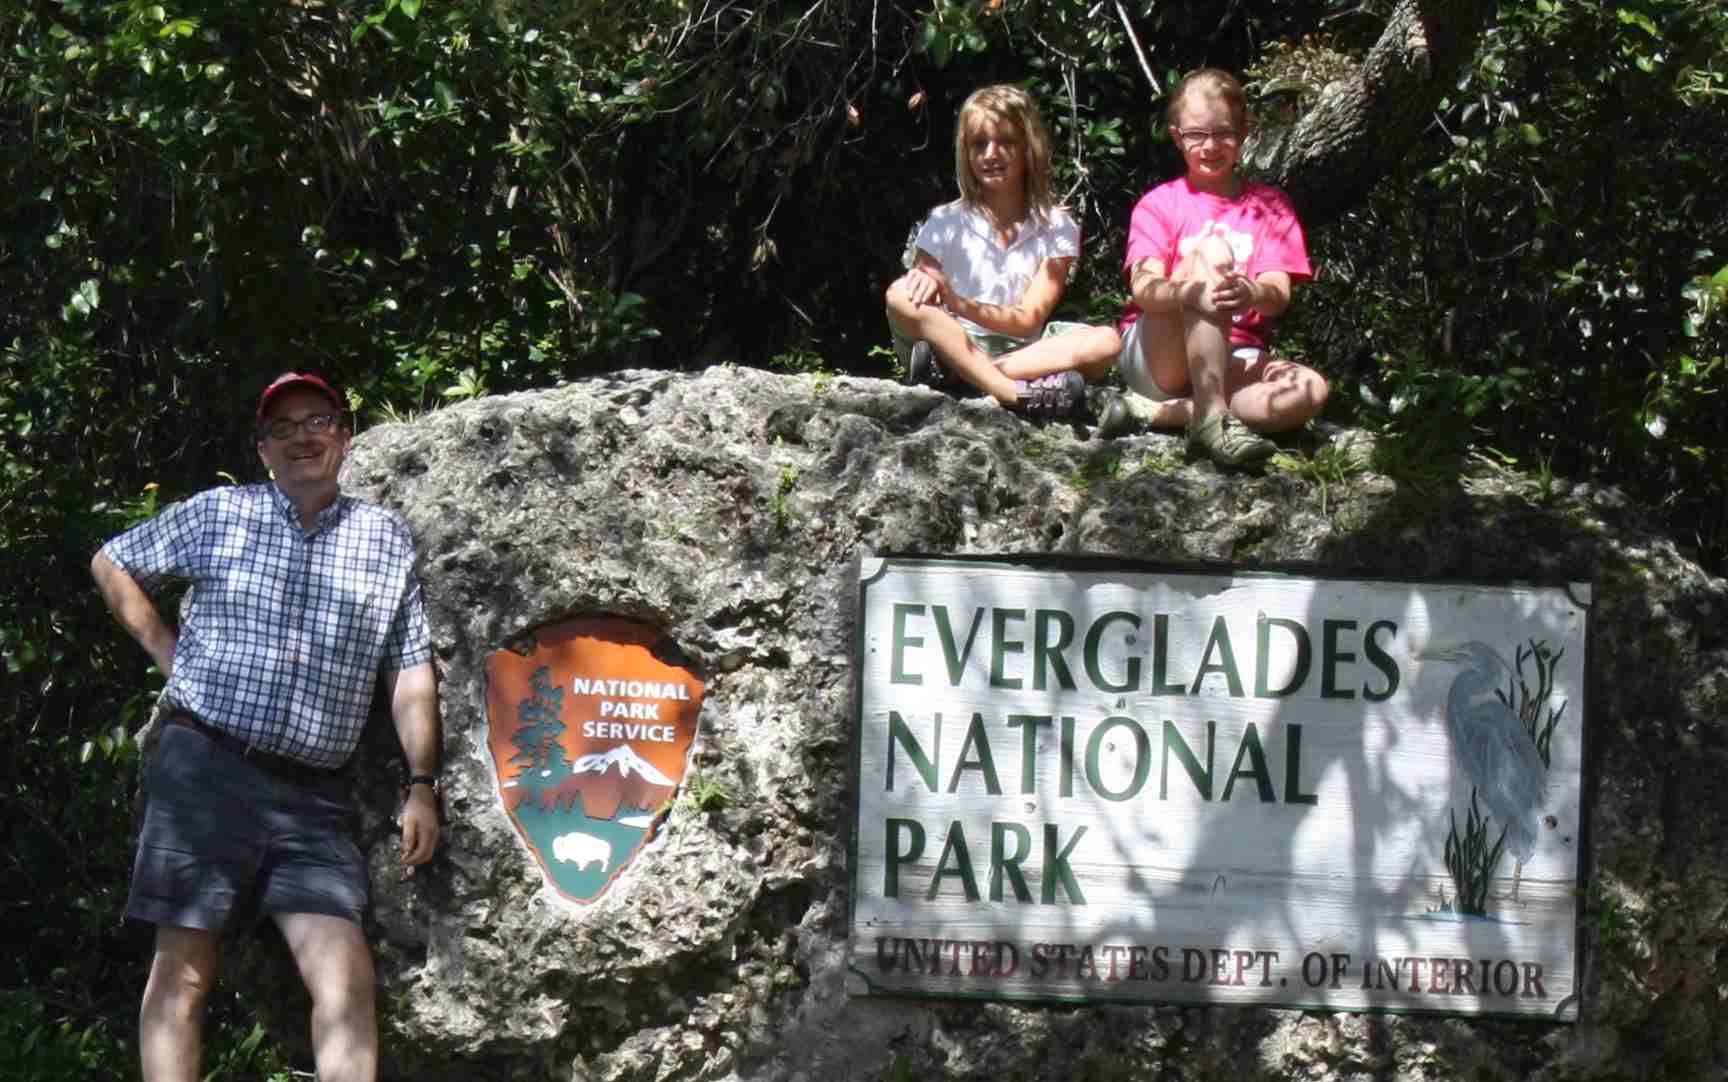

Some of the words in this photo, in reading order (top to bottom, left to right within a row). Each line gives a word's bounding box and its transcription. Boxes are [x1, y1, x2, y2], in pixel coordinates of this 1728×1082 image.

[890, 602, 1399, 702] EVERGLADES
[573, 678, 689, 700] NATIONAL
[601, 702, 659, 720] PARK
[583, 721, 676, 742] SERVICE
[886, 711, 1319, 806] NATIONAL
[884, 818, 1089, 906] PARK
[876, 937, 1019, 978] UNITED
[1031, 943, 1169, 983] STATES
[1181, 948, 1287, 988] DEPT.
[1302, 951, 1350, 990] OF
[1362, 956, 1547, 998] INTERIOR
